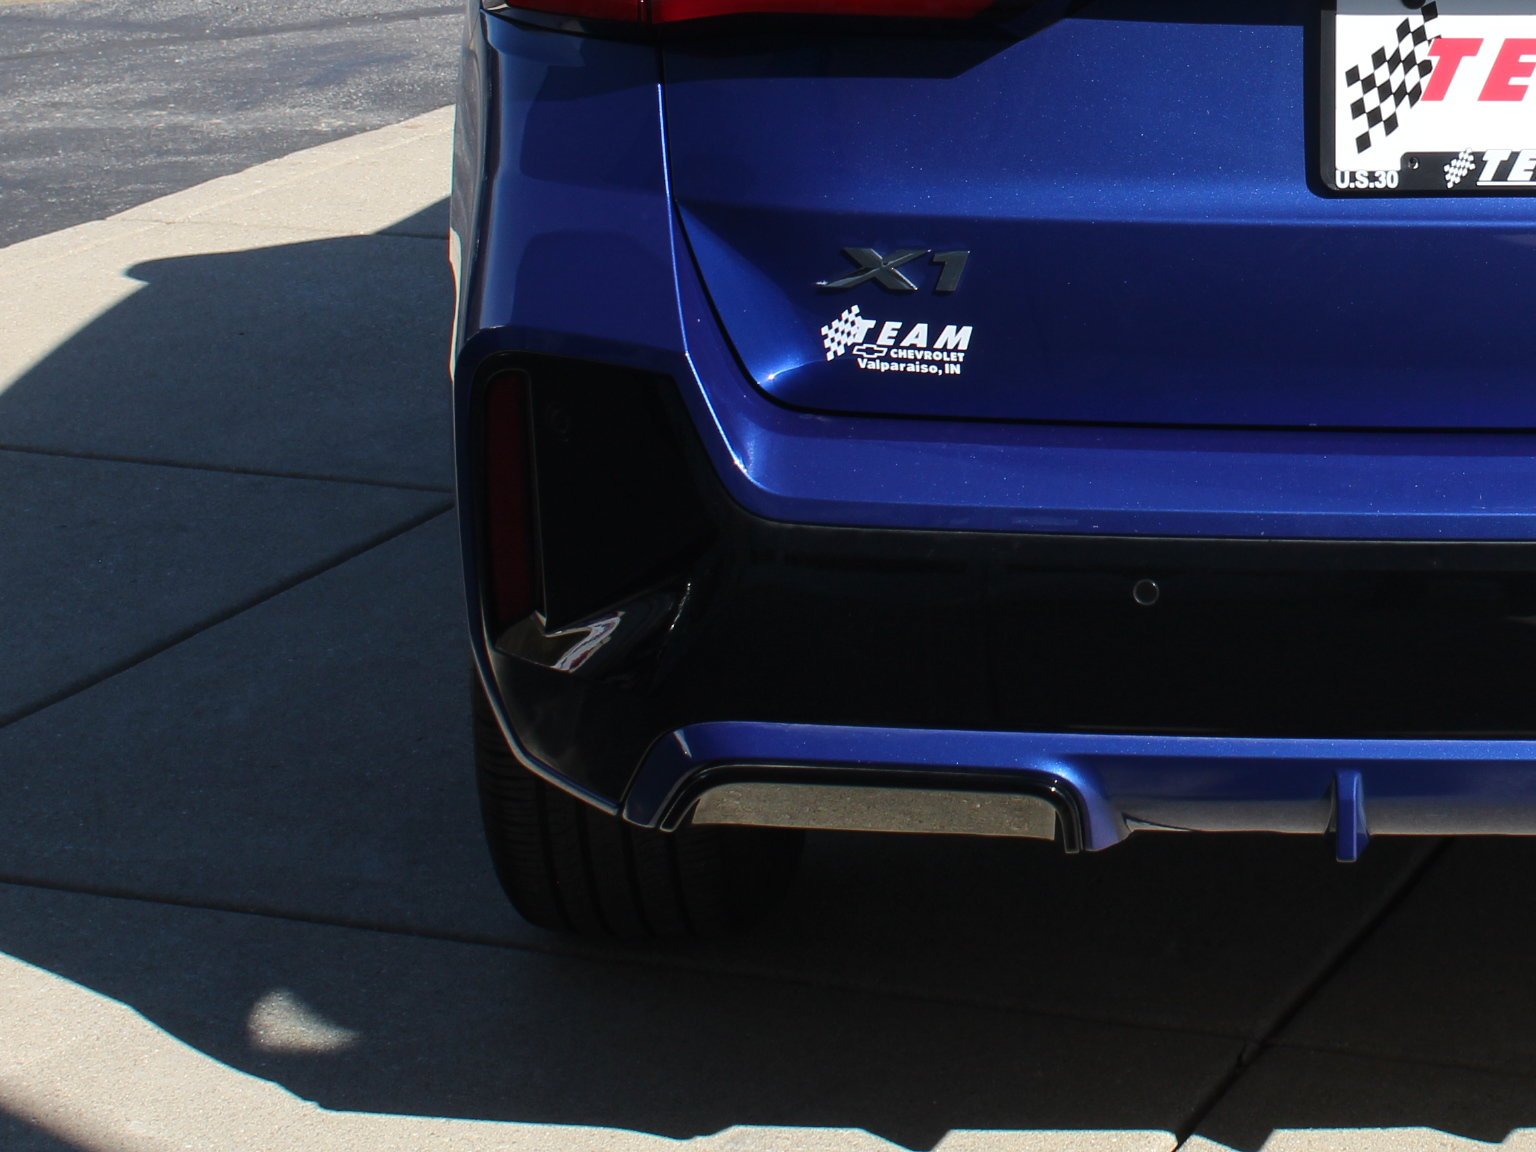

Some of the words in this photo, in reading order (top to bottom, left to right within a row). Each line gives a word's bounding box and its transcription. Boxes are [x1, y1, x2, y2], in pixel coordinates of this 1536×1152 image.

[815, 248, 971, 292] X1
[852, 319, 973, 350] TEAM
[857, 357, 943, 376] Valparaiso,
[945, 363, 961, 375] IN
[889, 348, 965, 362] CHEVROLET
